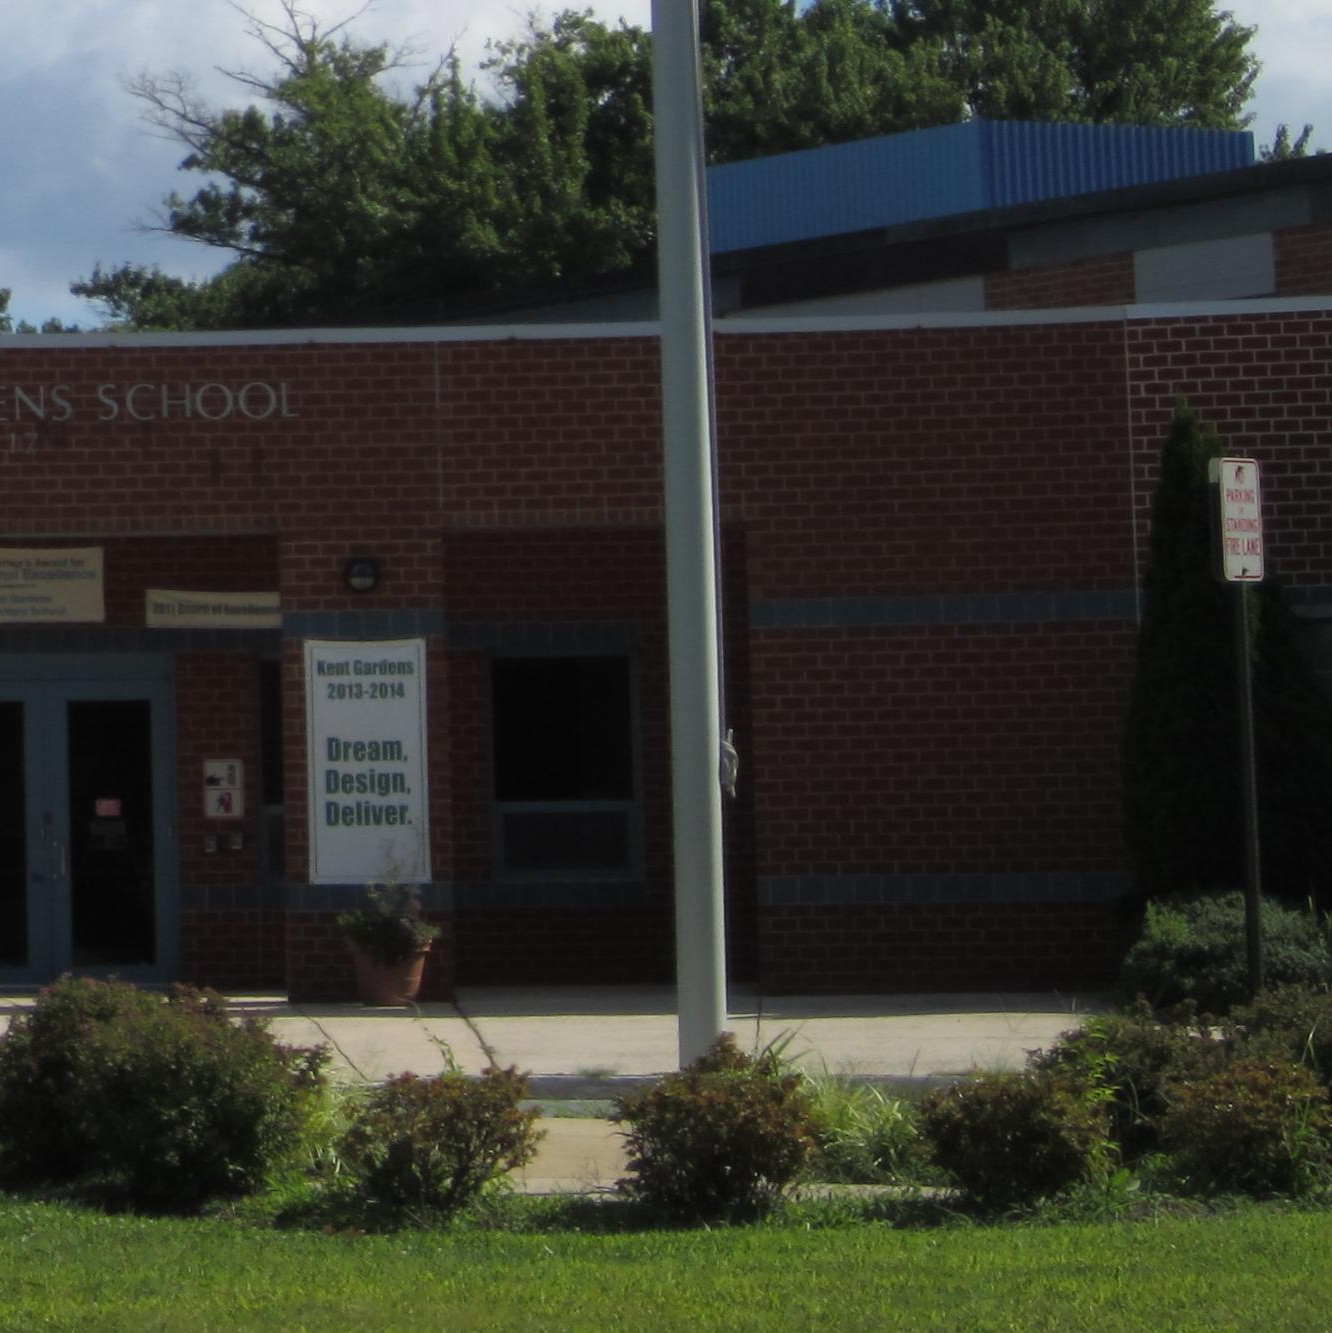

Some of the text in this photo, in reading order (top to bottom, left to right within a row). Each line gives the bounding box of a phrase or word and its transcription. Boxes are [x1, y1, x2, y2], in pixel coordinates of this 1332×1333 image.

[97, 382, 300, 421] SCHOOL
[317, 659, 414, 675] Kent Gardens
[327, 683, 405, 700] 2013-2014
[326, 737, 408, 763] Dream,
[325, 769, 411, 796] Design,
[325, 801, 412, 827] Deliver.
